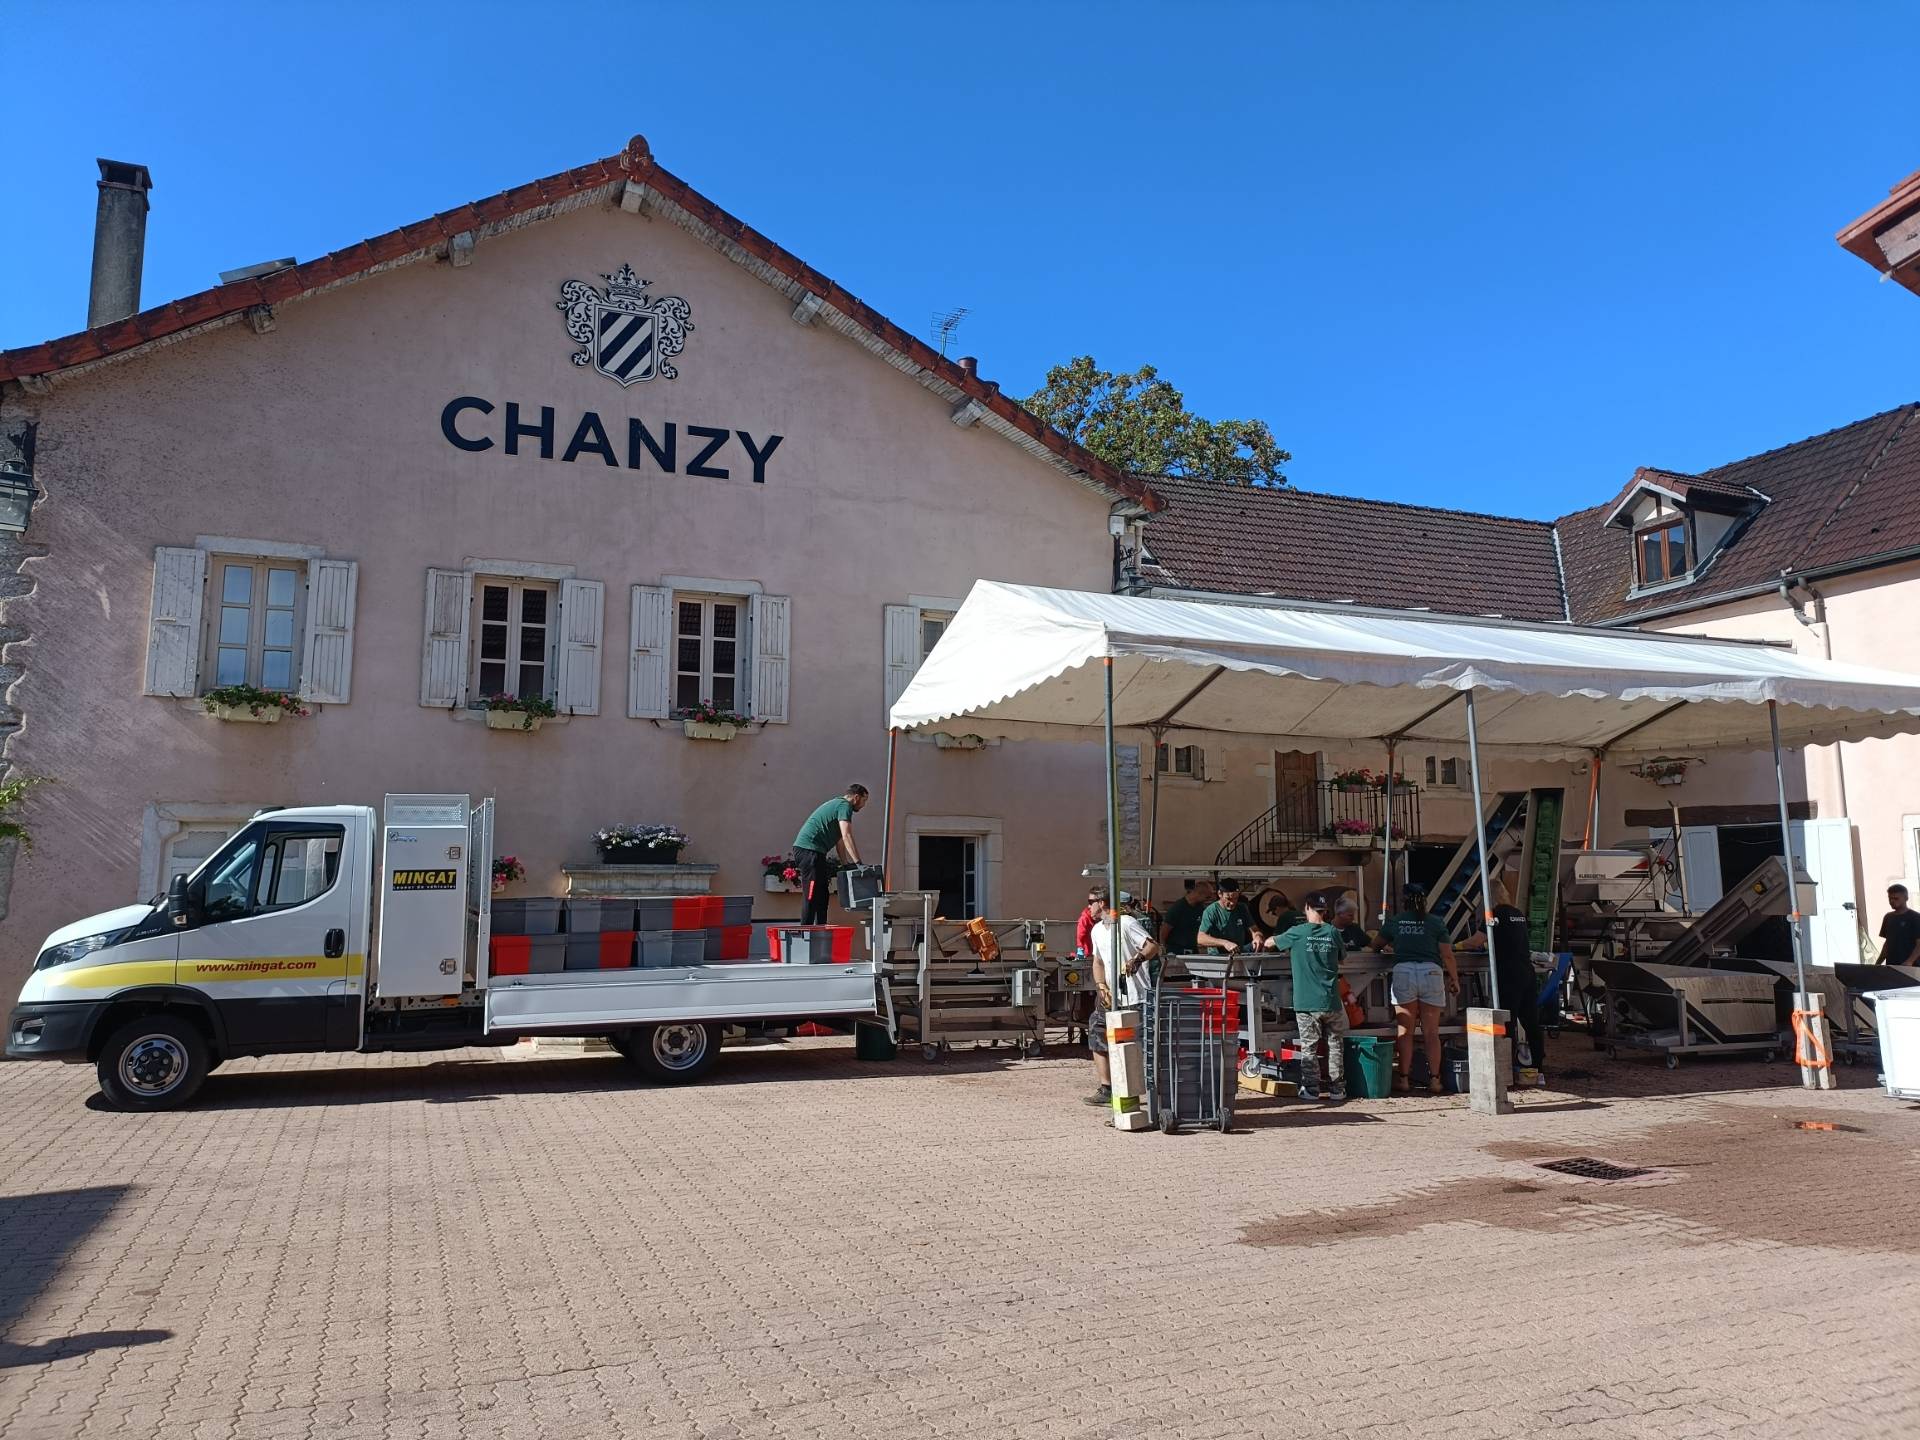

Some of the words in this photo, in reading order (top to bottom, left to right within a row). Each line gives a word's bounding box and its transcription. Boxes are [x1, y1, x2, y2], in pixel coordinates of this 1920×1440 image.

[440, 396, 785, 484] CHANZY
[393, 871, 456, 885] MINGAT
[1398, 925, 1425, 935] 2022
[196, 960, 317, 973] www.mingat.com
